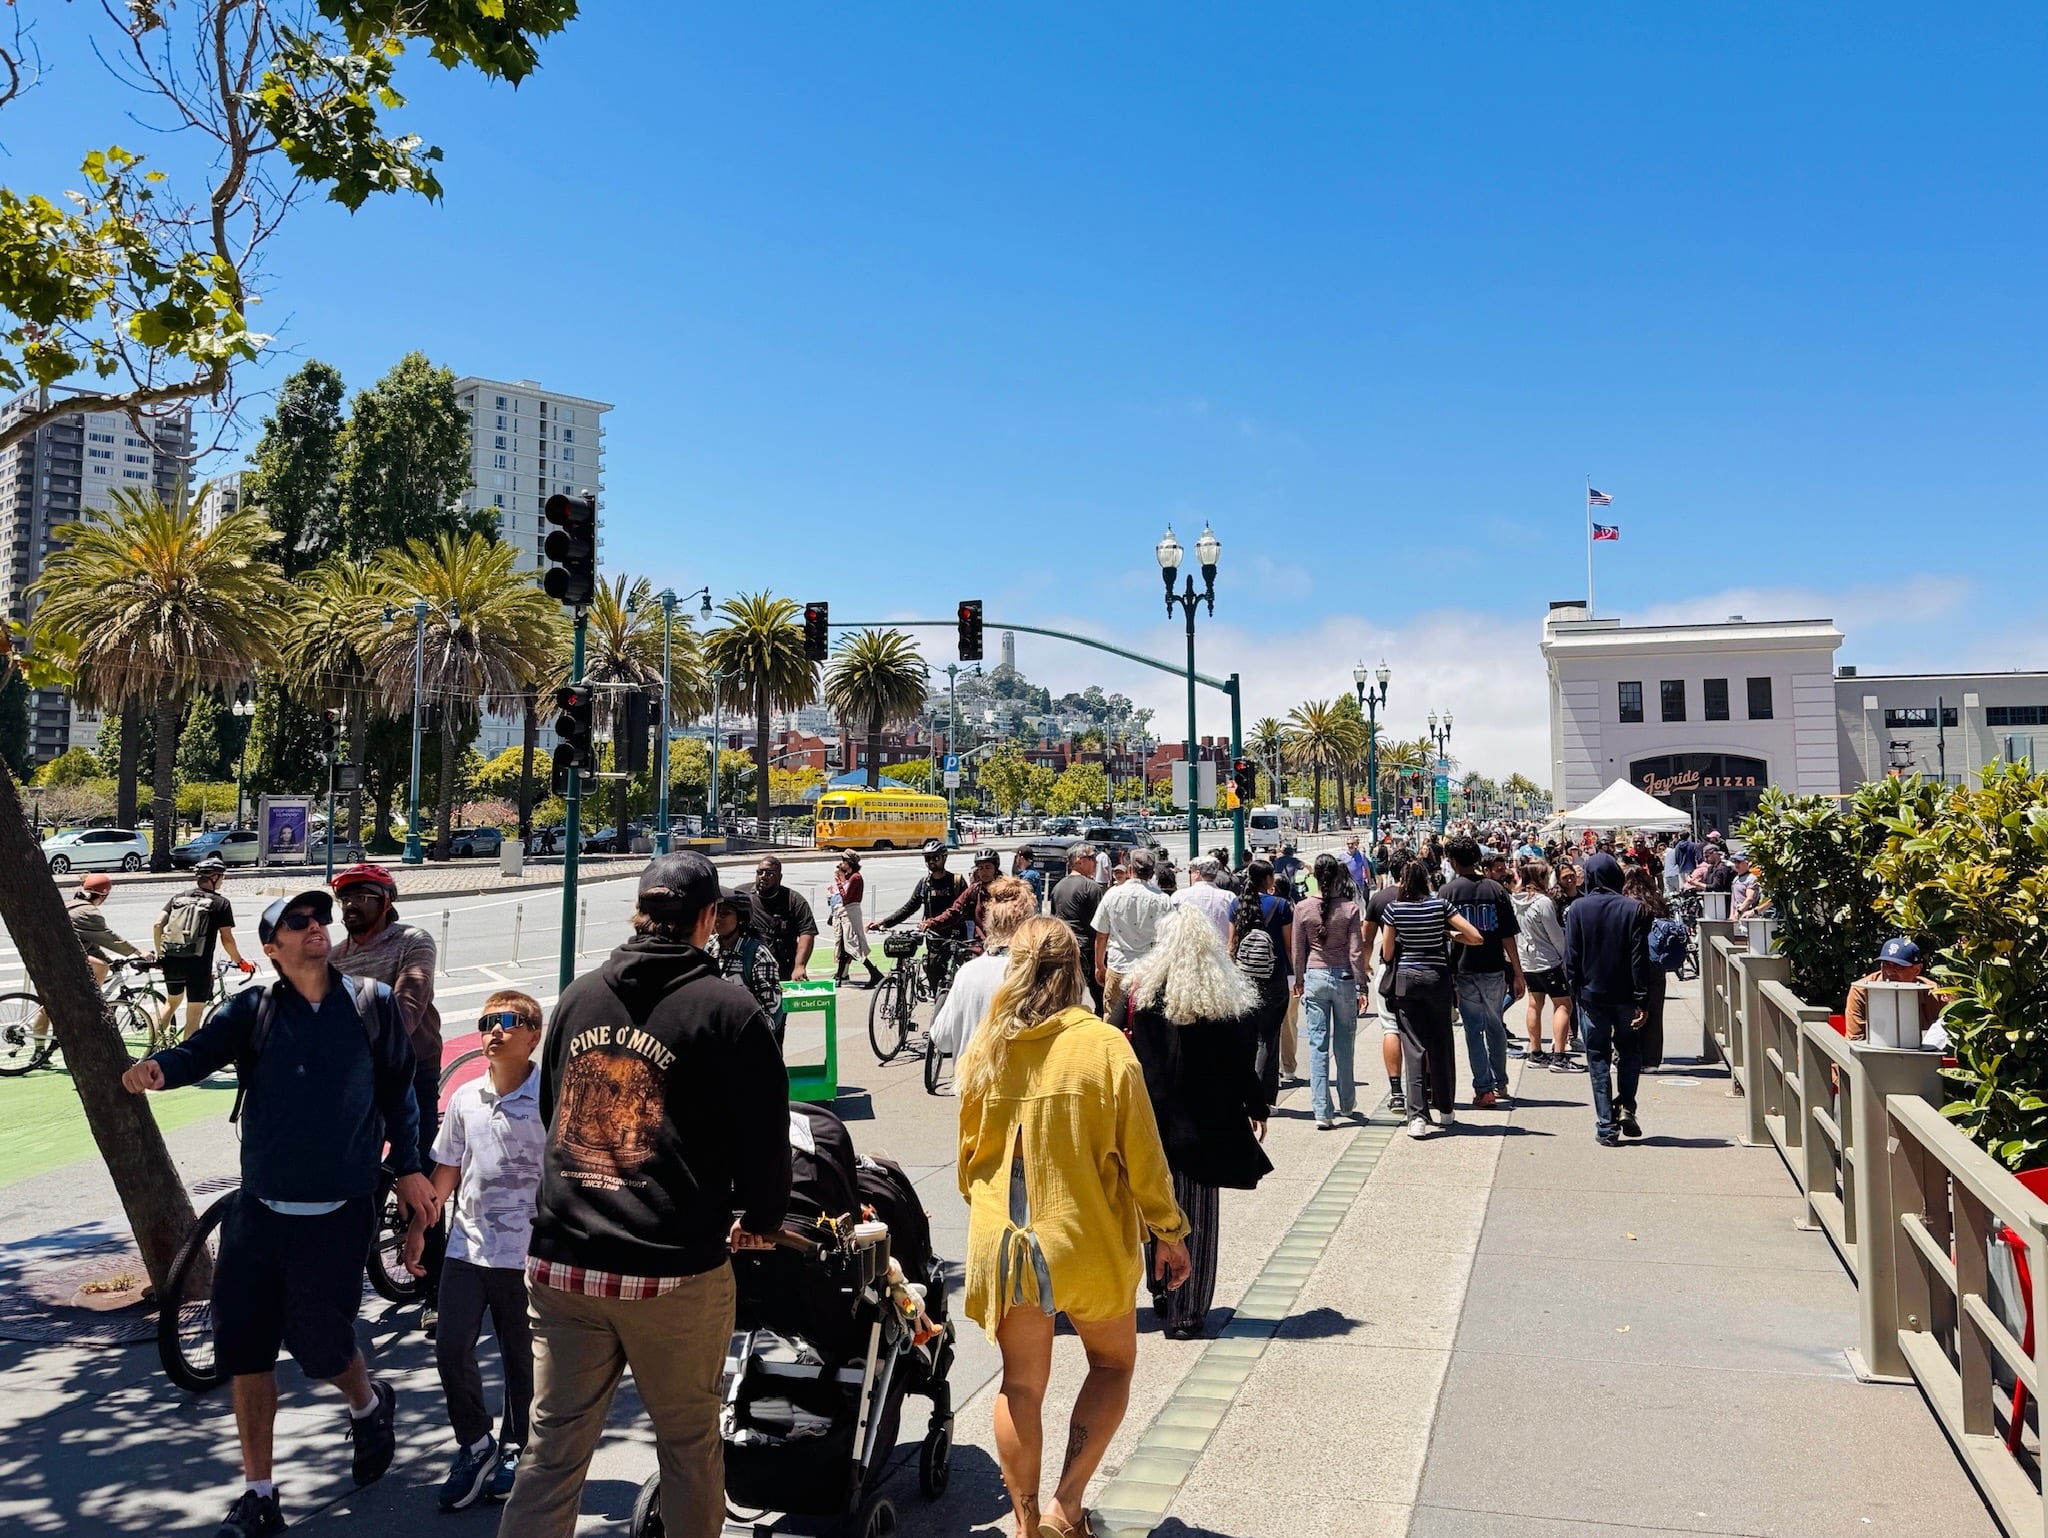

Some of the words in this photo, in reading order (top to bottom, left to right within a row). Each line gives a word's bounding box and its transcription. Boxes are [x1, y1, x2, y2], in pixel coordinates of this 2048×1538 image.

[1643, 769, 1700, 795] Joyride
[1704, 776, 1756, 787] PIZZA
[801, 1000, 816, 1008] Chef
[817, 999, 830, 1007] Cart
[569, 1025, 611, 1058] PINE
